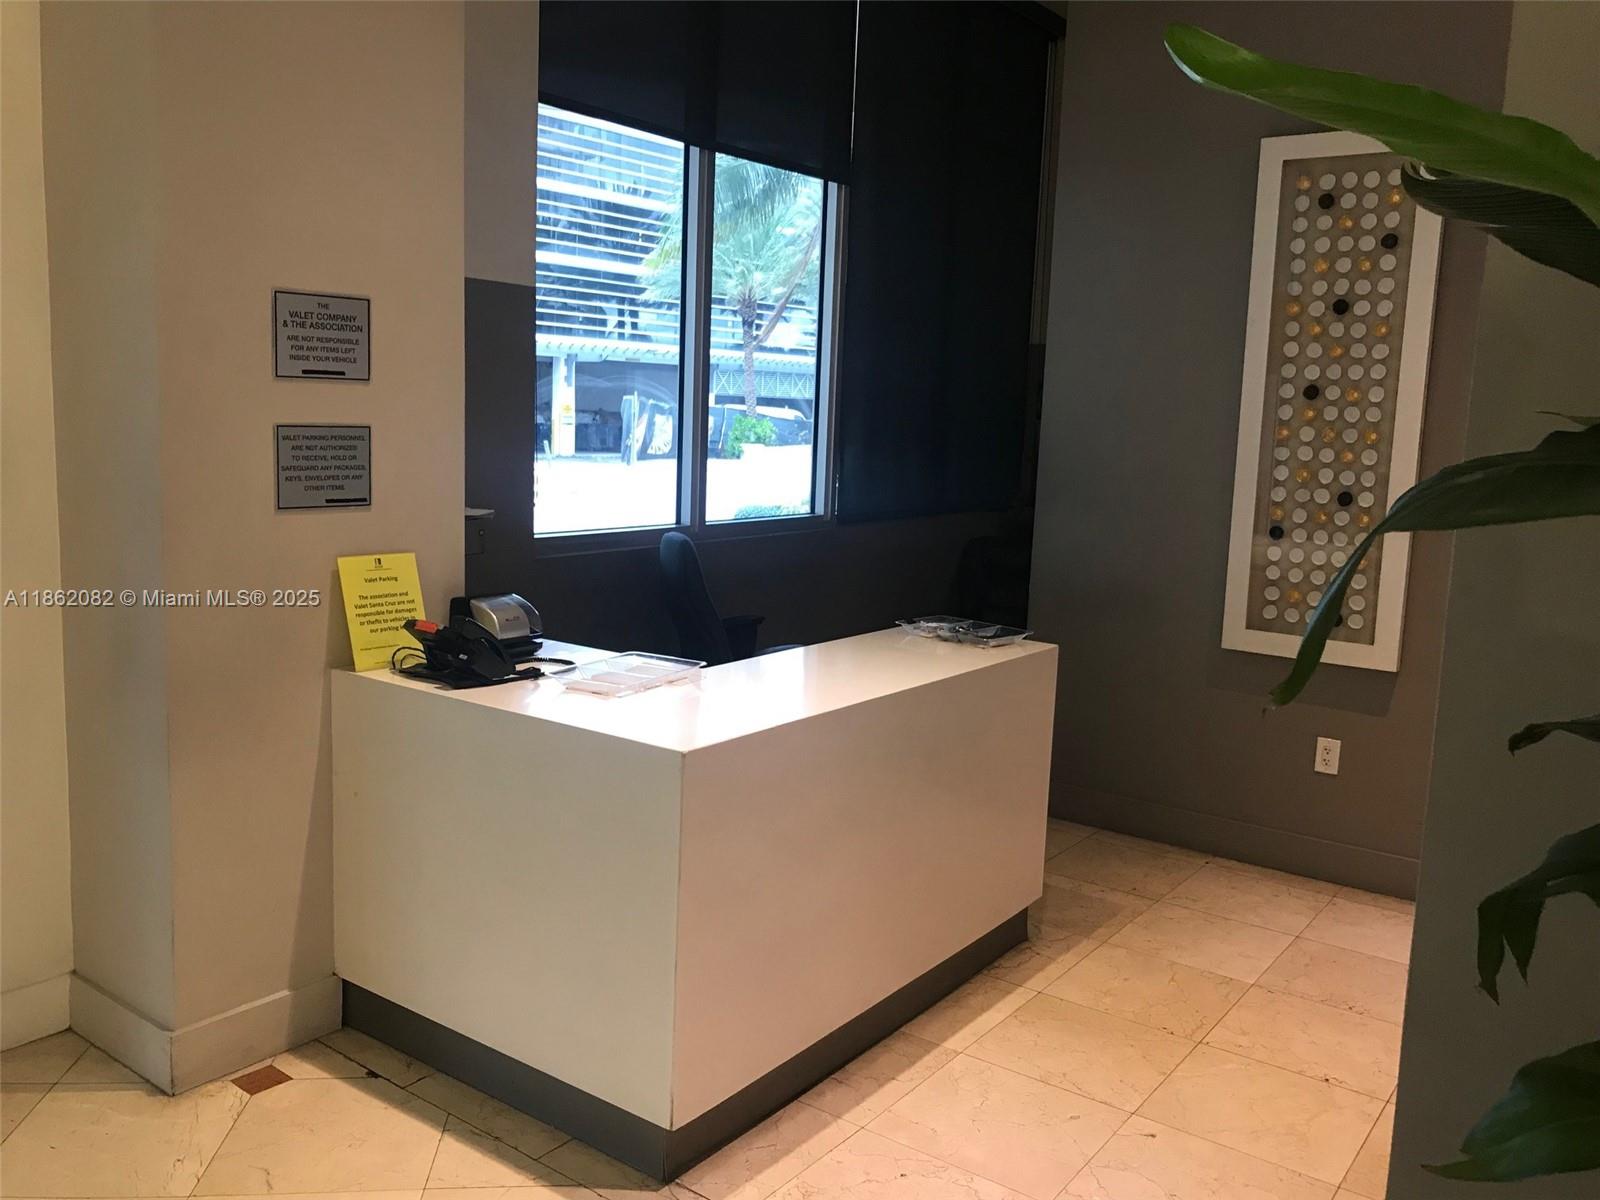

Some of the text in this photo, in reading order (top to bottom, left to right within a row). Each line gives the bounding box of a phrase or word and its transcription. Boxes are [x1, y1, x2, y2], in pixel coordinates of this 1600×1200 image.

[289, 310, 357, 322] VALET COMPANY
[291, 320, 306, 329] THE
[310, 322, 363, 332] ASSOCIATION
[317, 337, 359, 345] RESPONSIBLE
[355, 610, 385, 618] responsible
